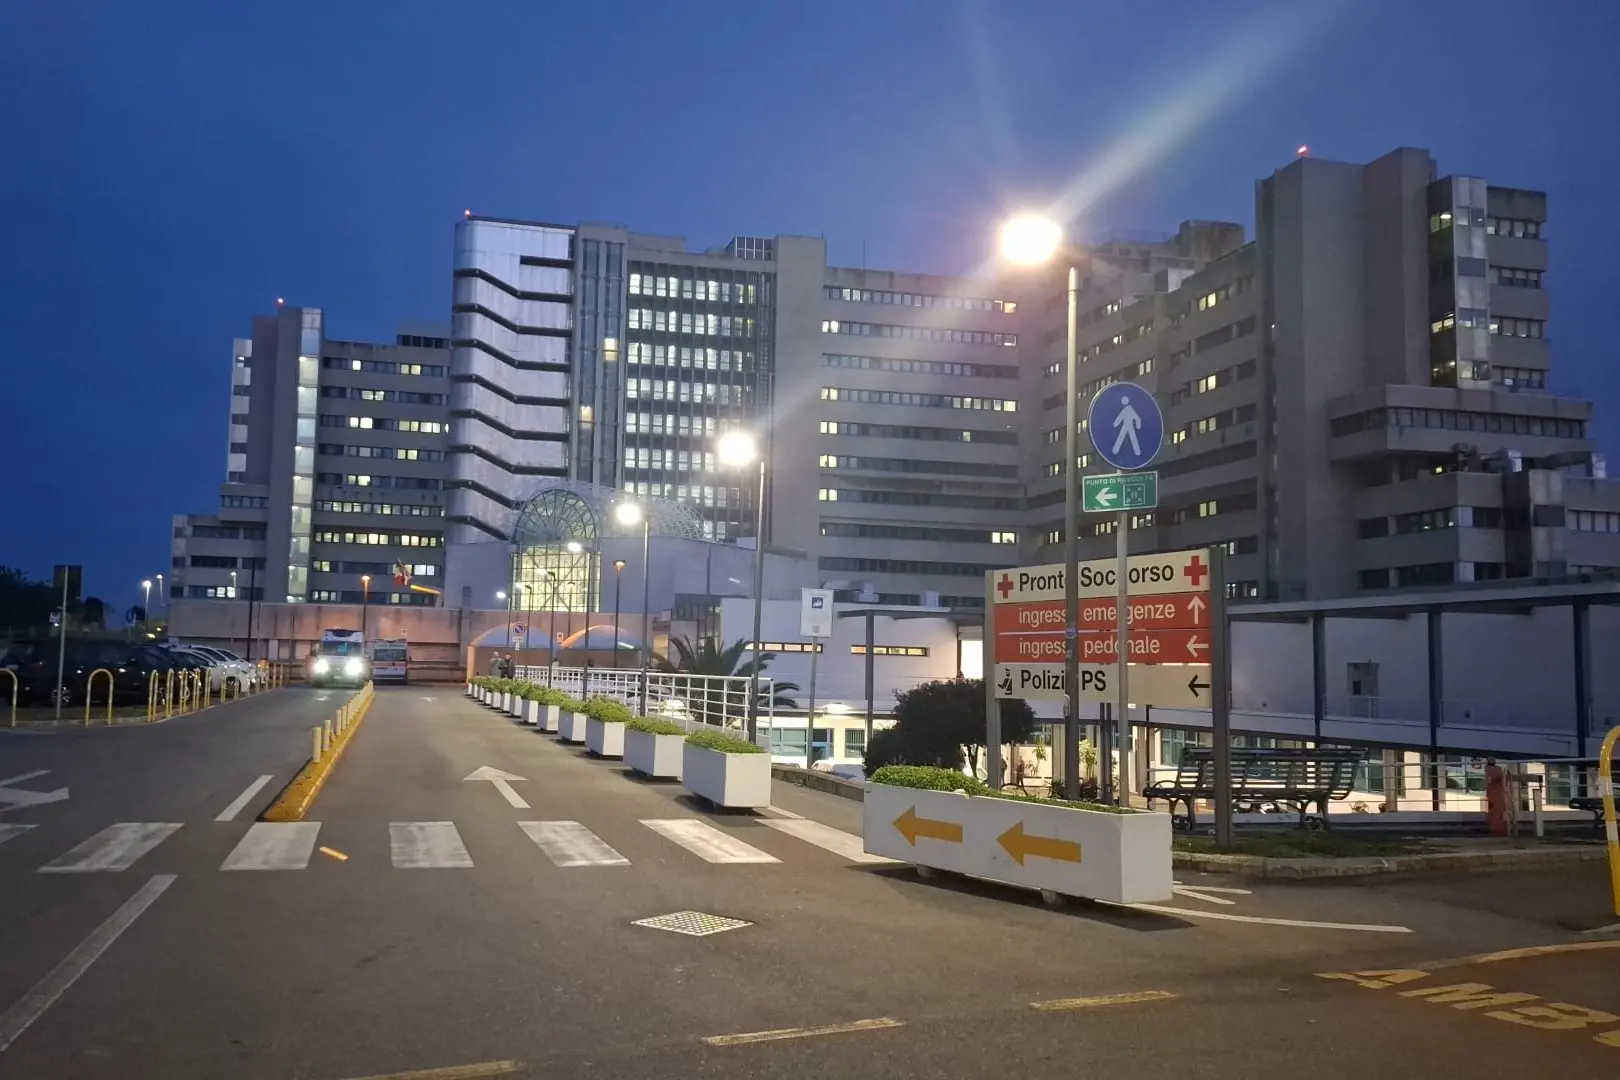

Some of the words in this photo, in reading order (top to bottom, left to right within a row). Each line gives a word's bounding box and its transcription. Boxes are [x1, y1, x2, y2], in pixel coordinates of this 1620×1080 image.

[1019, 569, 1065, 592] Pront
[1080, 564, 1174, 588] Socorso
[1019, 607, 1067, 628] ingress
[1083, 603, 1175, 625] emegenze
[1019, 637, 1067, 659] ingress
[1020, 669, 1065, 690] Polizi
[1081, 670, 1107, 692] PS
[1312, 968, 1620, 1048] AMB
